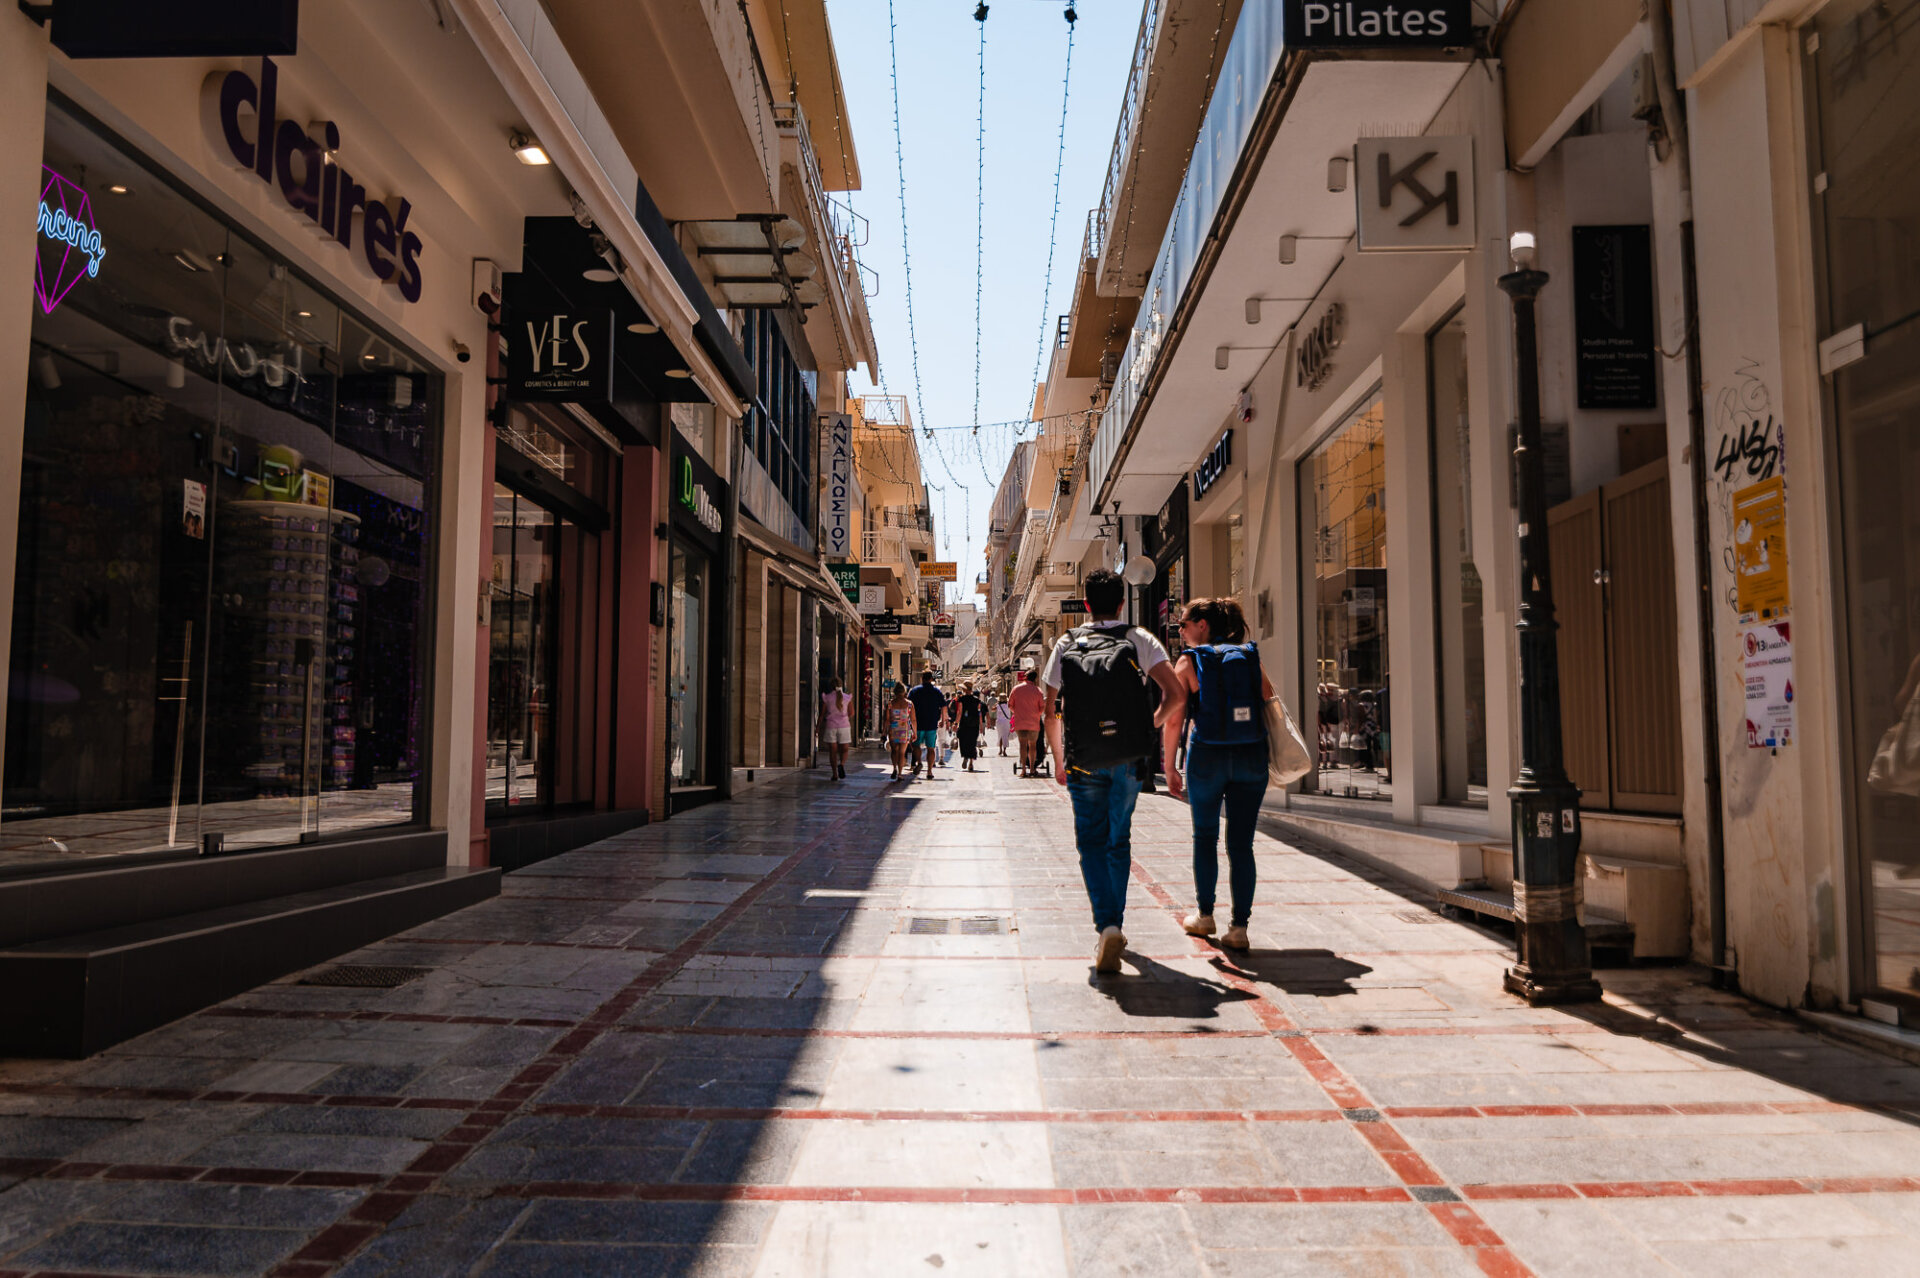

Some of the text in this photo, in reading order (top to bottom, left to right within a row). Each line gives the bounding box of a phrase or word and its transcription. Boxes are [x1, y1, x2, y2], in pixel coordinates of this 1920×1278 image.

[1302, 2, 1448, 37] Pilates
[220, 55, 423, 304] claire's
[37, 200, 106, 279] rcing
[526, 314, 591, 374] YES
[831, 418, 847, 553] ΑΝΑΓΝΩΣΤΟΥ
[837, 580, 857, 590] LEN
